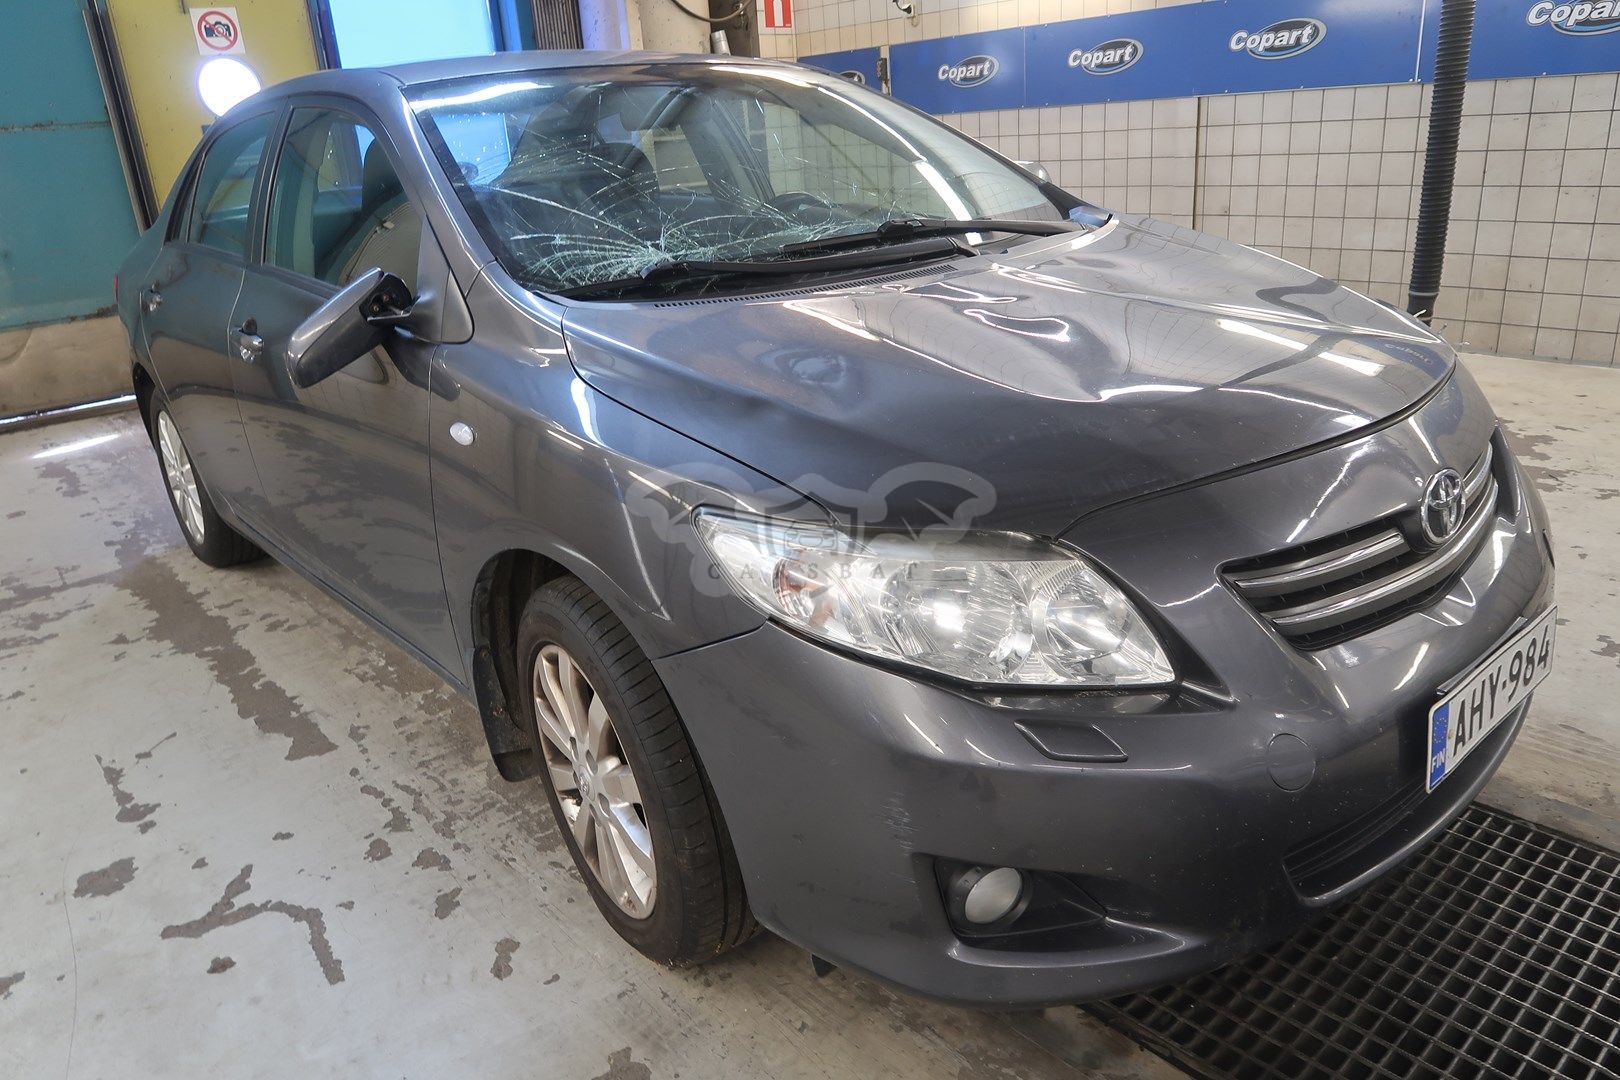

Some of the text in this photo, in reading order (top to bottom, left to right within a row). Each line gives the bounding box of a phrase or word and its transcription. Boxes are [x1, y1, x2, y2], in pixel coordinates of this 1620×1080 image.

[1528, 1, 1620, 27] Copa
[1229, 23, 1315, 52] Copart
[1068, 43, 1134, 68] Copart
[938, 60, 991, 81] Copart
[1452, 624, 1551, 758] AHY-984
[1431, 747, 1446, 773] FIN
